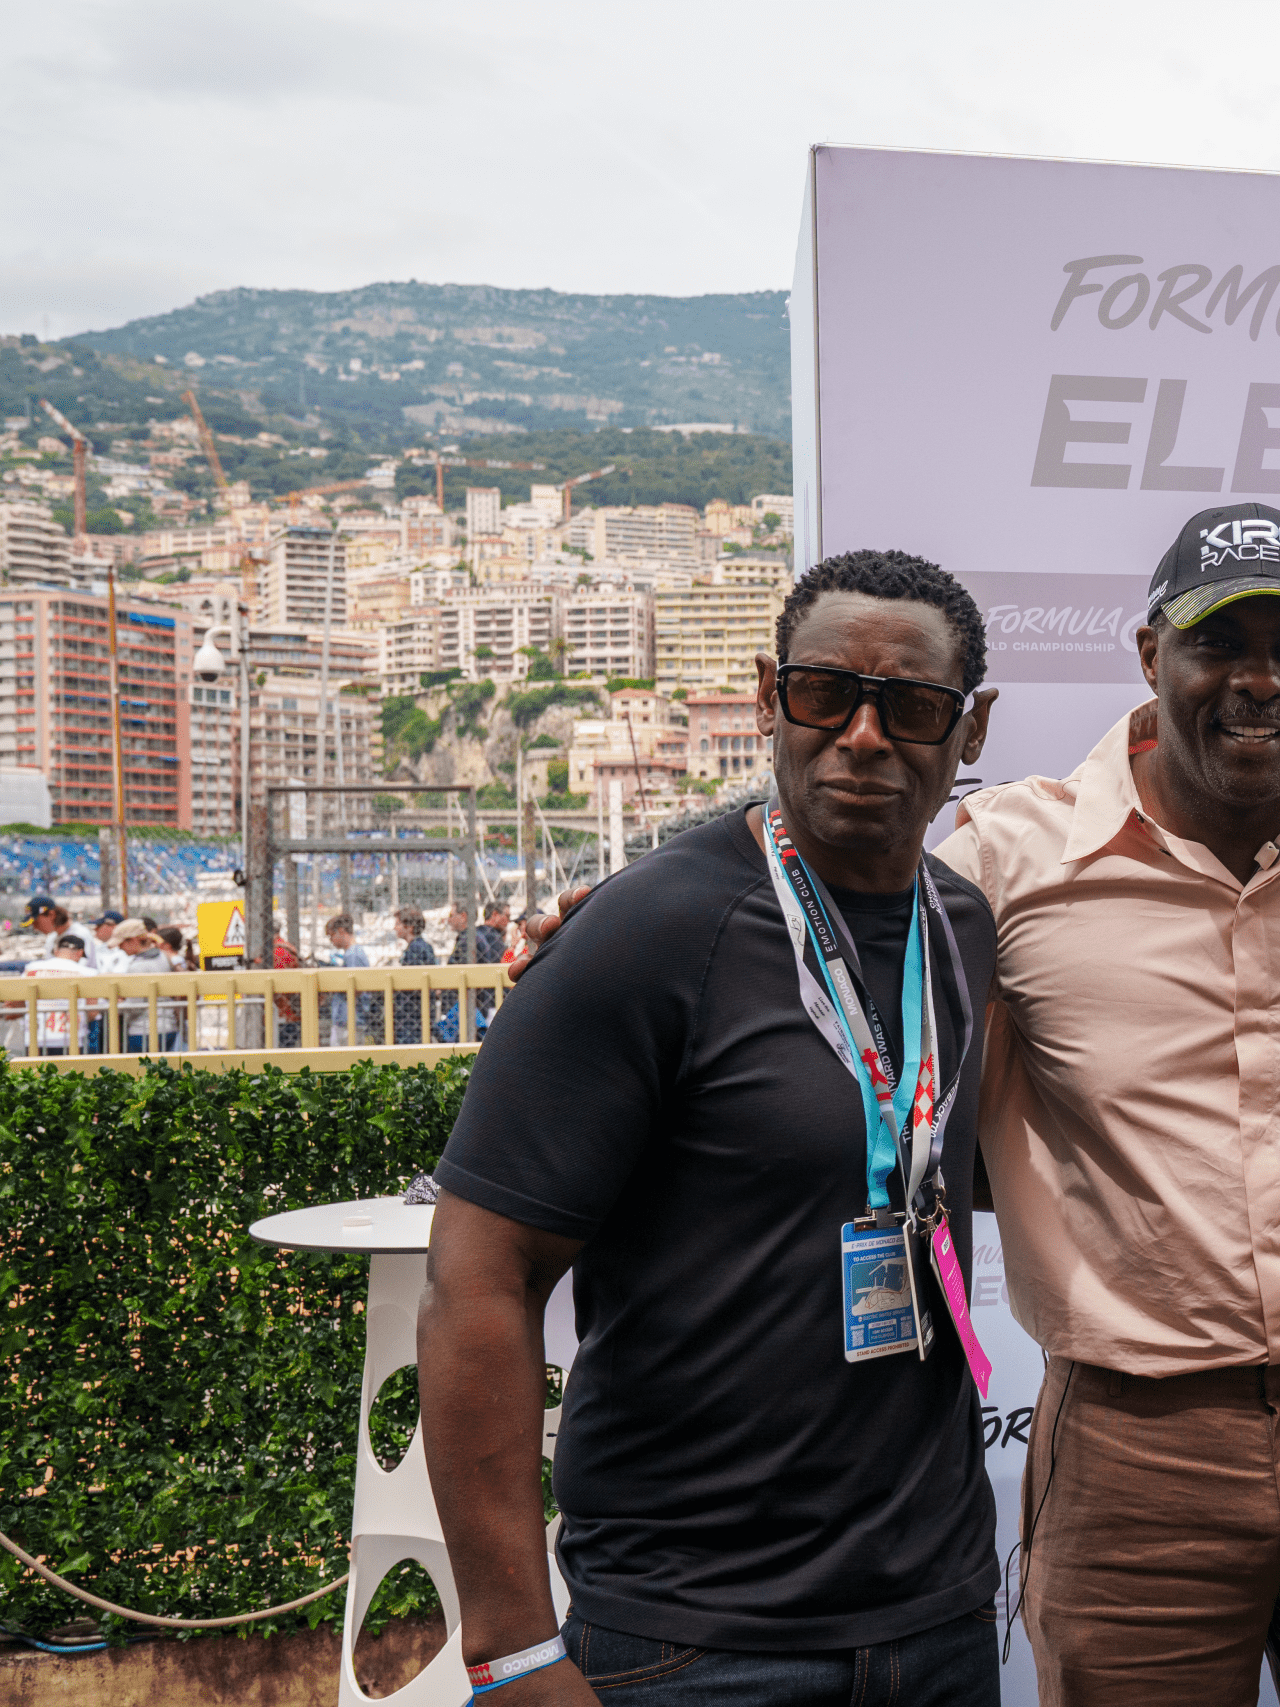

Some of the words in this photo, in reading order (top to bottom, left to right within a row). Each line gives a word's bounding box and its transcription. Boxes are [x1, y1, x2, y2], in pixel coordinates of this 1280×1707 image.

[985, 604, 1124, 637] FORMULA
[1013, 642, 1116, 653] CHAMPIONSHIP
[791, 868, 811, 898] CLUB
[834, 967, 859, 1016] MONACO
[874, 1023, 888, 1057] WAS
[882, 1056, 897, 1098] NYARD
[502, 1643, 560, 1674] MONACO
